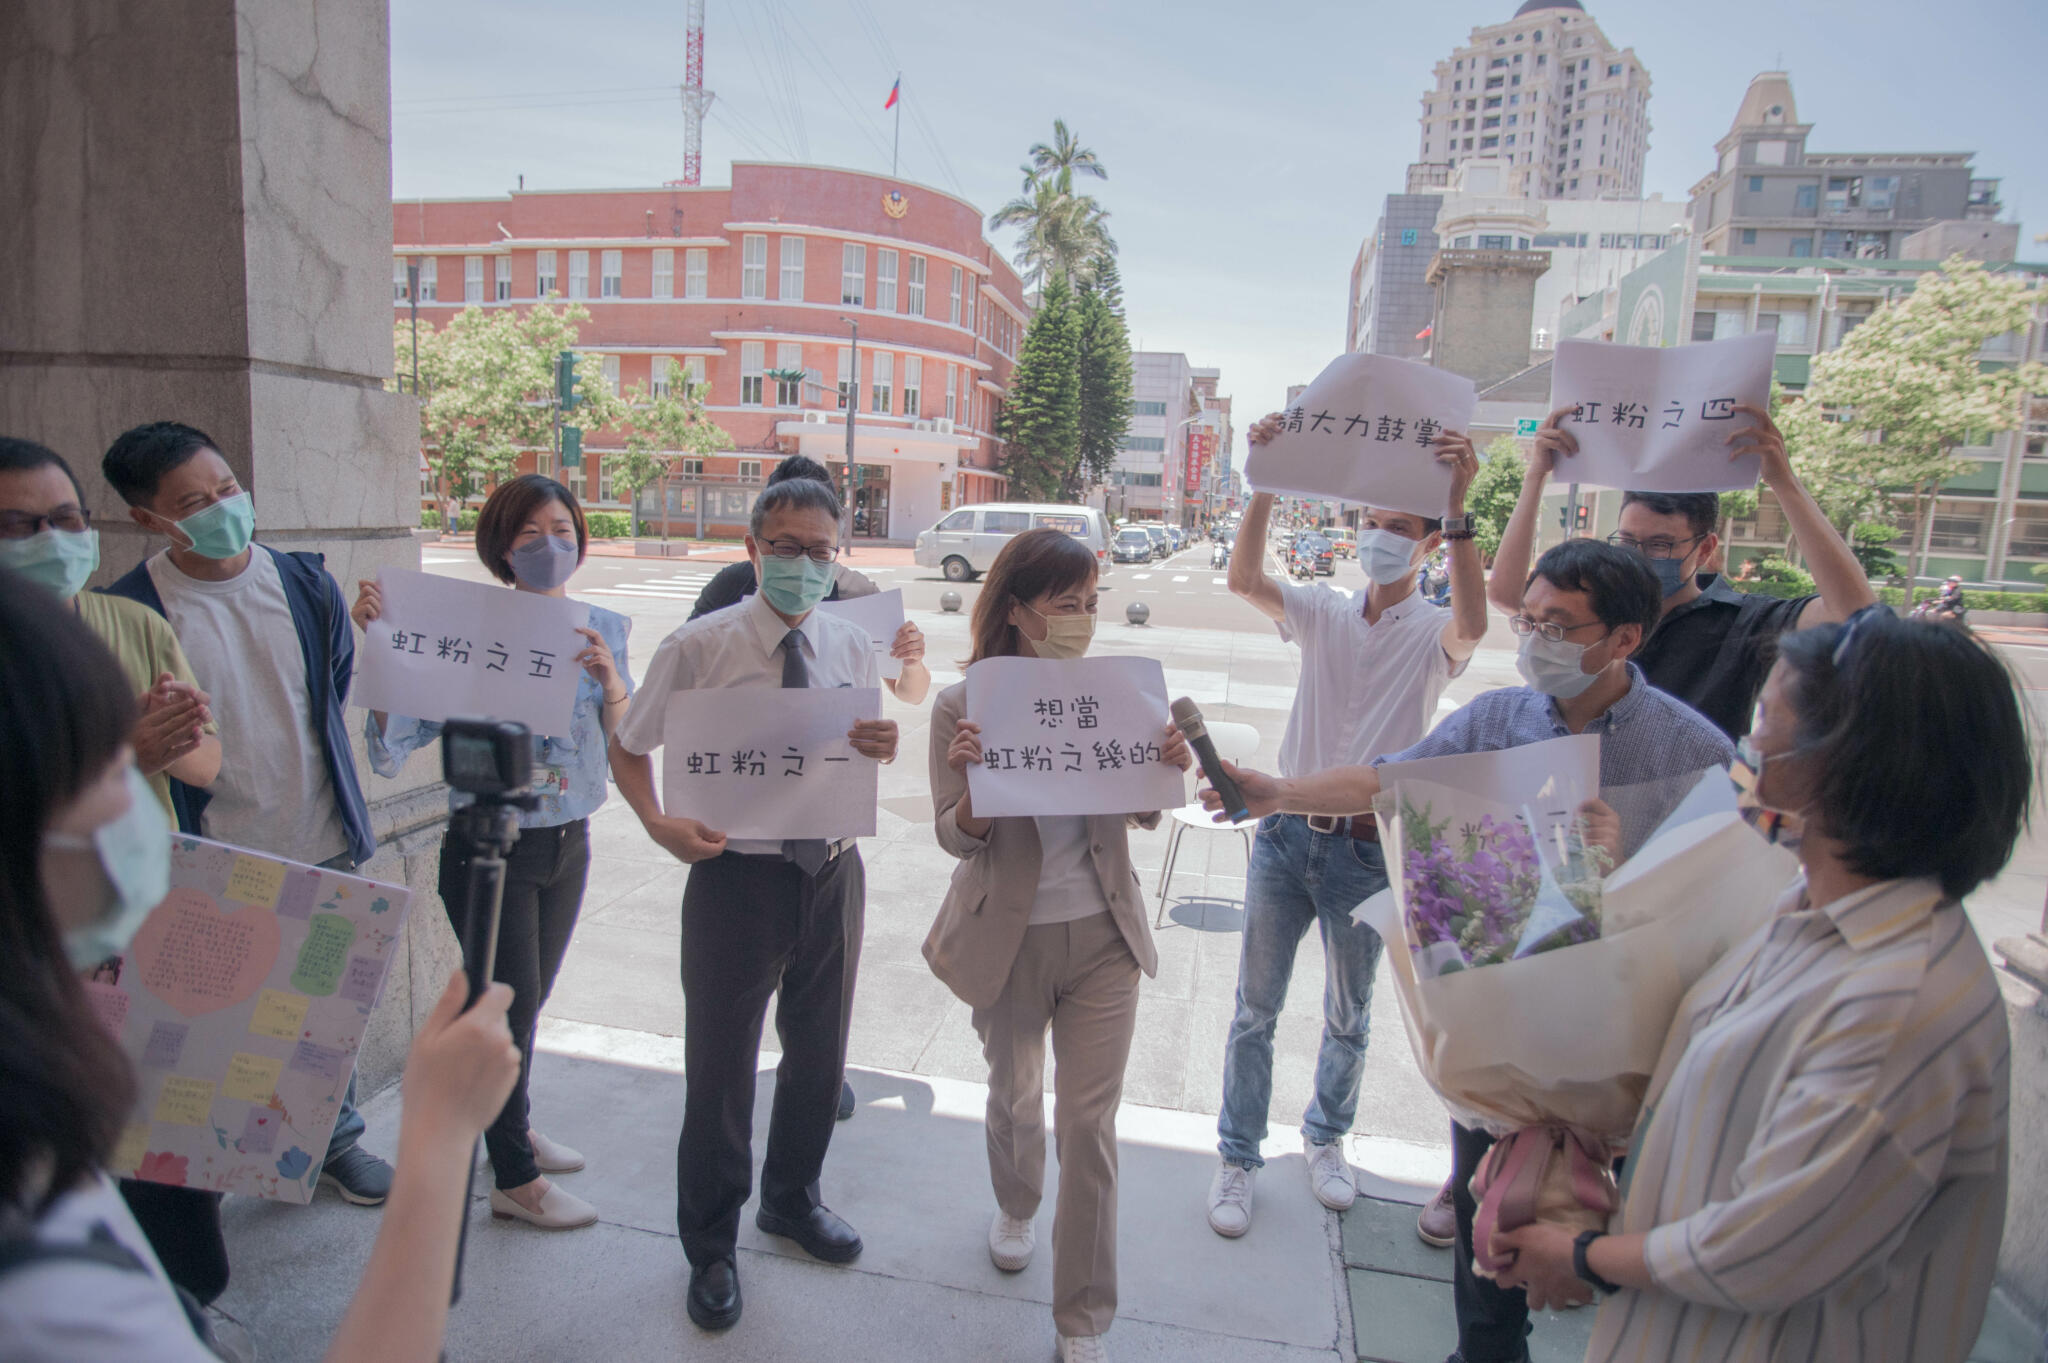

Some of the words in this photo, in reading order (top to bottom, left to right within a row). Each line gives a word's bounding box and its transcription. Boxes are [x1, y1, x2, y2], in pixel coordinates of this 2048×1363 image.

[1277, 406, 1442, 448] 請大力鼓掌
[1571, 398, 1736, 429] 虹粉之四
[392, 630, 556, 678] 虹粉之五
[1034, 695, 1099, 729] 想當
[687, 747, 849, 776] 虹粉之一
[984, 739, 1161, 772] 虹粉之幾的
